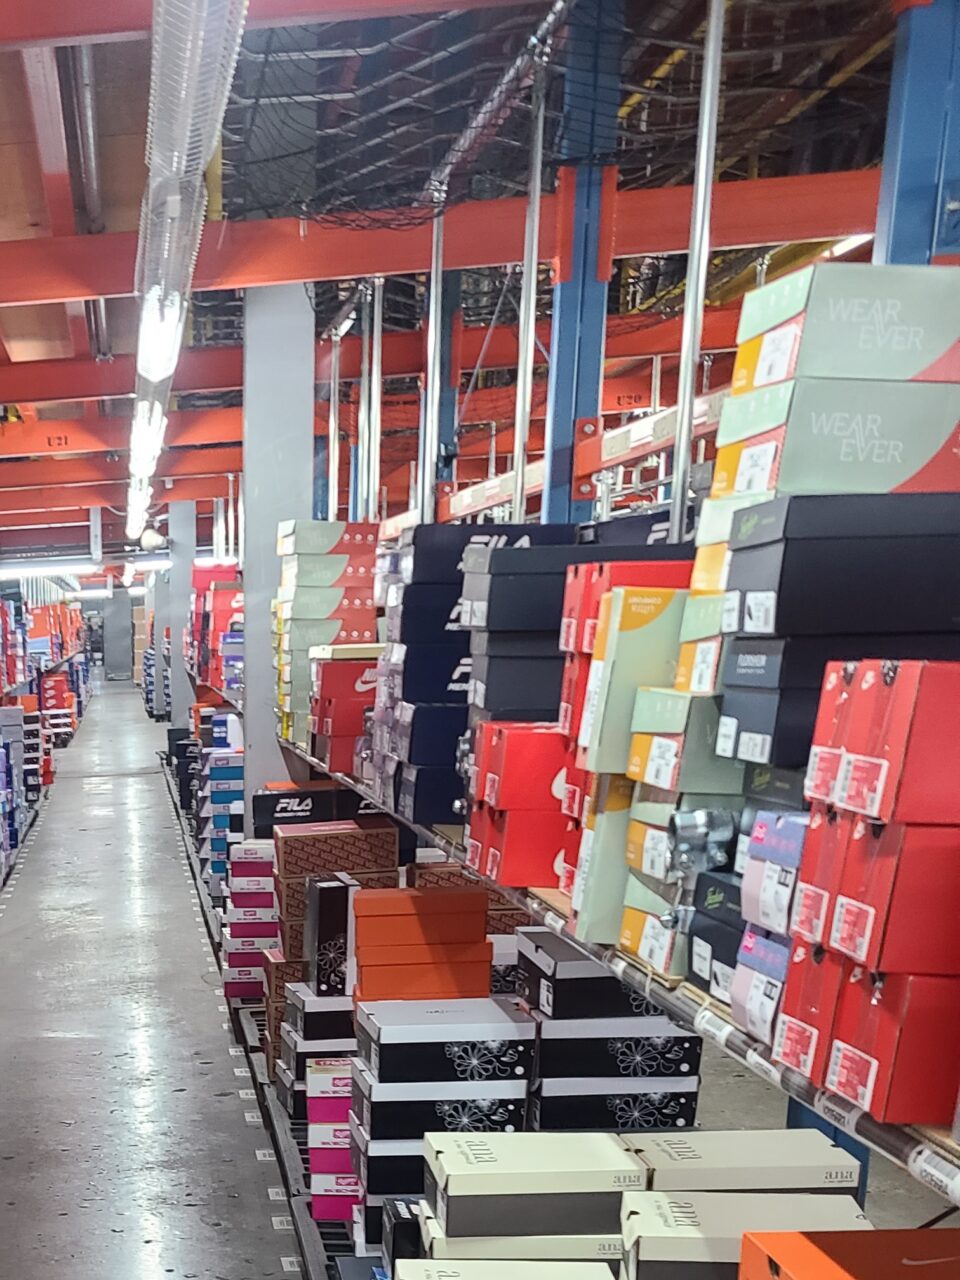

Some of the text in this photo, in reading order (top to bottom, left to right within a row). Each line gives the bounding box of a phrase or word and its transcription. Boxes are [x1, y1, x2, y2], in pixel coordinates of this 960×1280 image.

[828, 298, 901, 323] WEAR
[859, 325, 924, 351] EVER
[810, 411, 881, 437] WEAR
[840, 438, 904, 464] EVER
[276, 797, 313, 812] FILA
[613, 1174, 641, 1184] ana
[824, 1170, 854, 1181] ana
